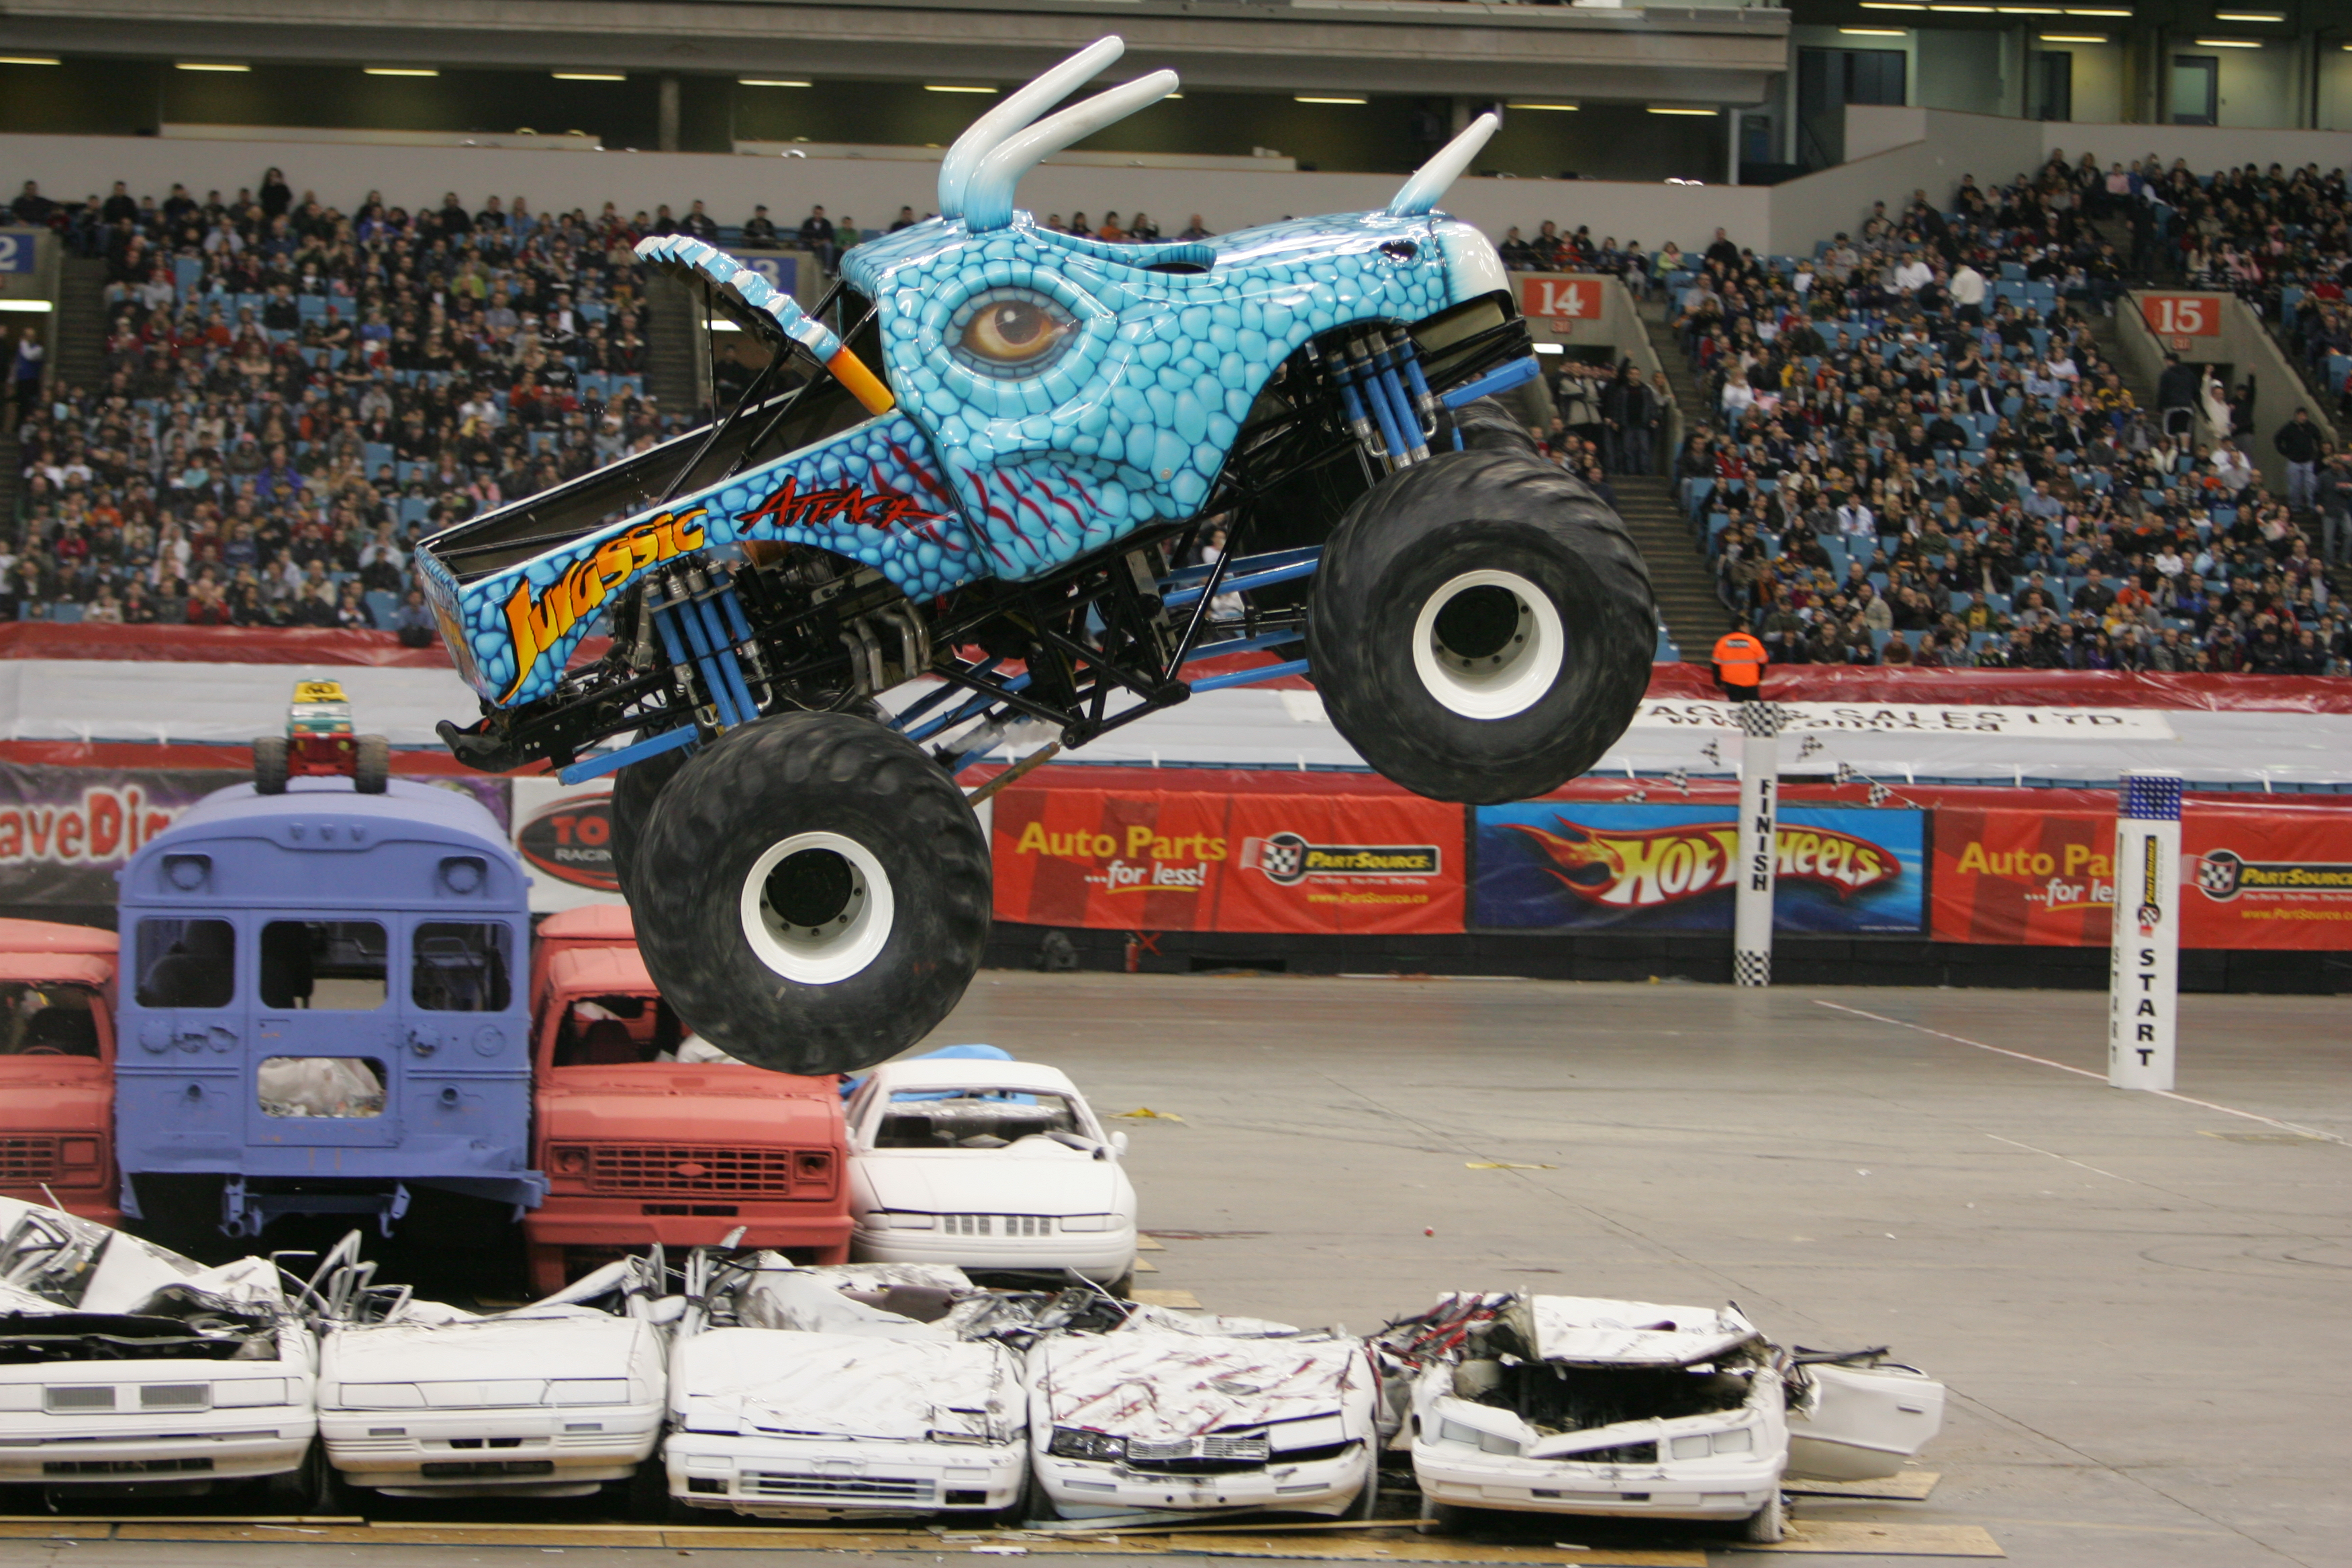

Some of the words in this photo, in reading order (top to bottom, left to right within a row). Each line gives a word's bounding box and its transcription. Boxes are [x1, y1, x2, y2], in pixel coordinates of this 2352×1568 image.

[1539, 281, 1585, 315] 14
[2159, 299, 2202, 333] 15
[1833, 708, 2008, 724] SALES
[1015, 822, 1118, 858] Auto
[1126, 826, 1228, 861] Parts
[1752, 779, 1772, 891] FINISH
[1152, 862, 1208, 886] less!
[1956, 842, 2055, 876] Auto
[2090, 879, 2116, 903] le
[2136, 948, 2157, 1067] START
